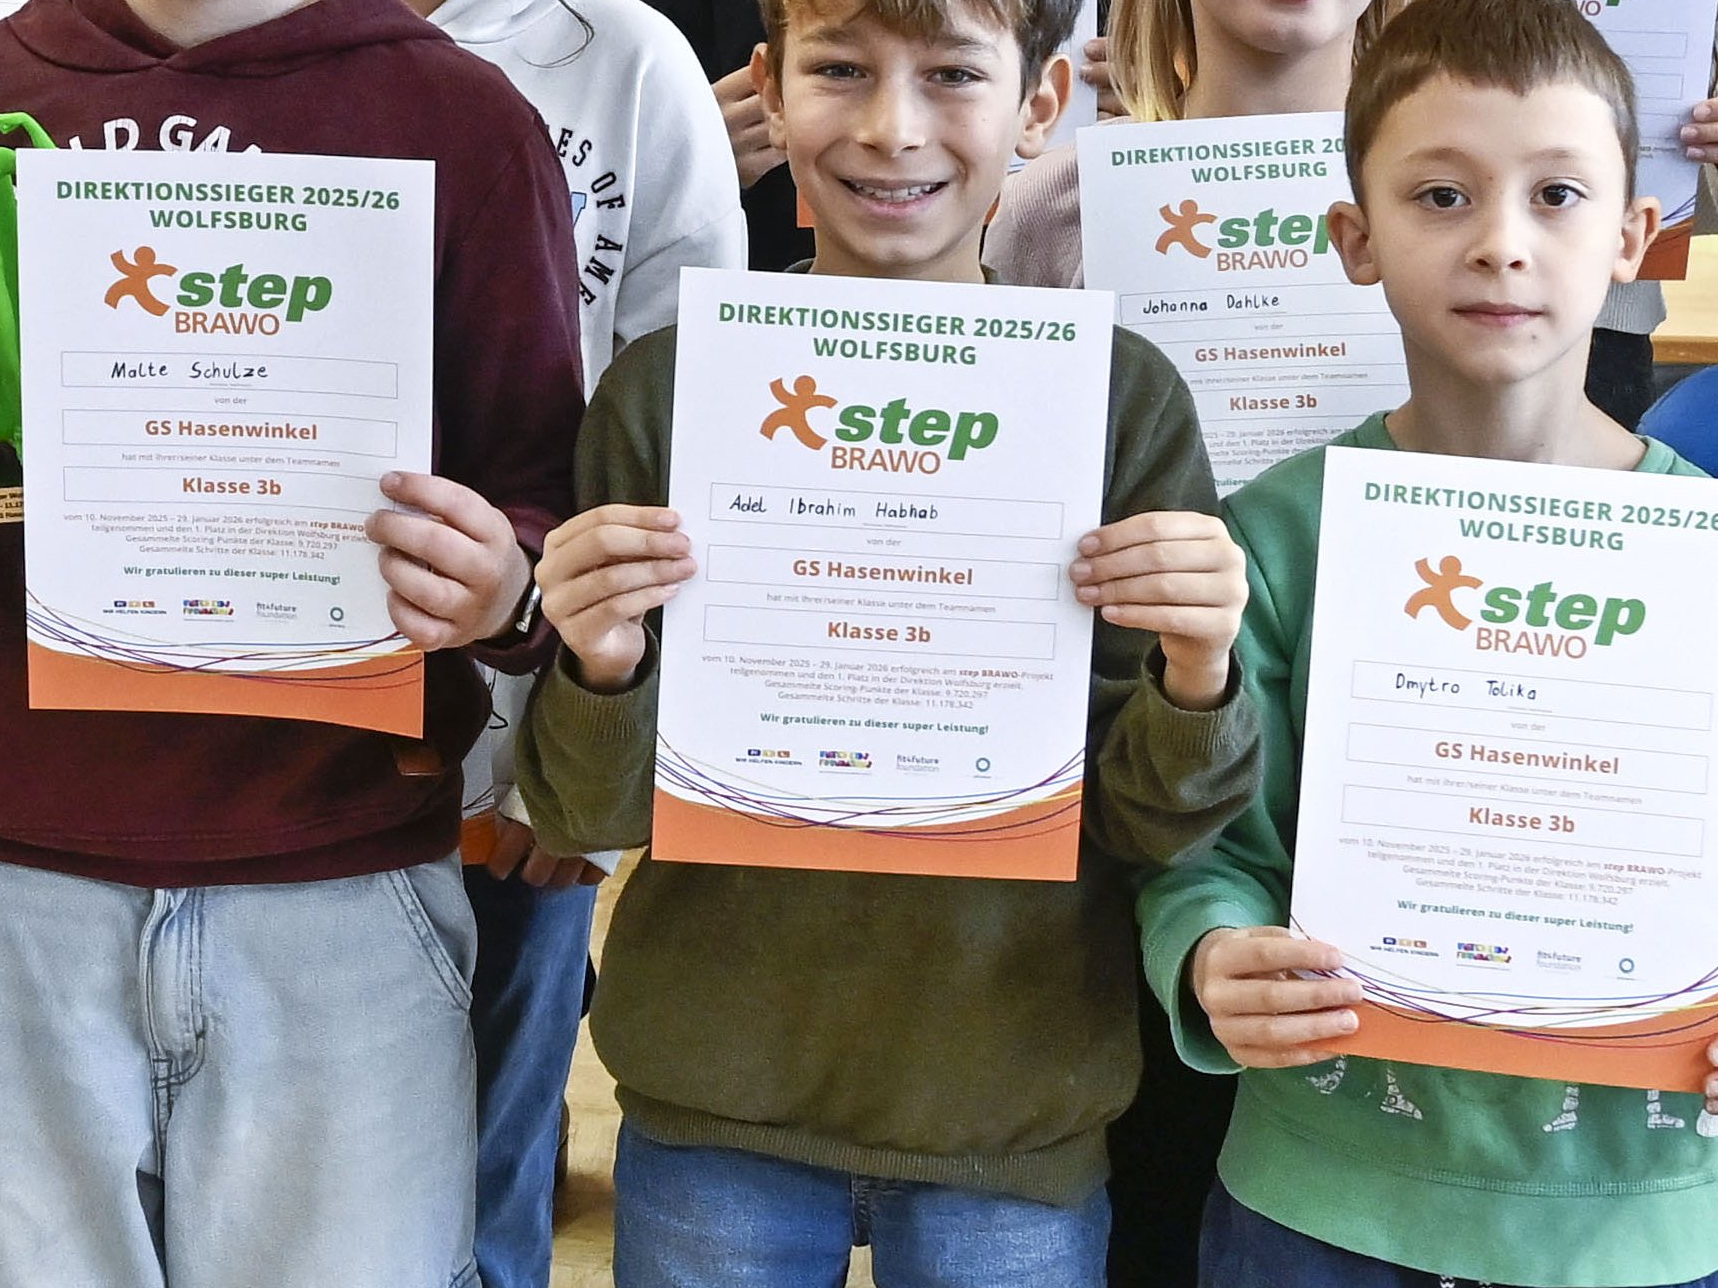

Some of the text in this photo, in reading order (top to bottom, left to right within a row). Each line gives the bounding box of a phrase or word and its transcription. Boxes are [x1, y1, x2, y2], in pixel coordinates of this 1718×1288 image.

[56, 181, 400, 210] DIREKTIONSSIEGER 2025/26
[150, 209, 308, 231] WOLFSBURG
[176, 264, 333, 322] step
[1143, 294, 1280, 314] Johanna Dahlke
[174, 312, 280, 335] BRAWO
[111, 362, 268, 380] Malte Schulze
[145, 420, 317, 441] GS Hasenwinkel
[182, 478, 281, 495] Klasse 3b
[730, 494, 766, 514] Adel
[790, 498, 856, 518] Ibrahim
[1396, 674, 1460, 699] Dmytro
